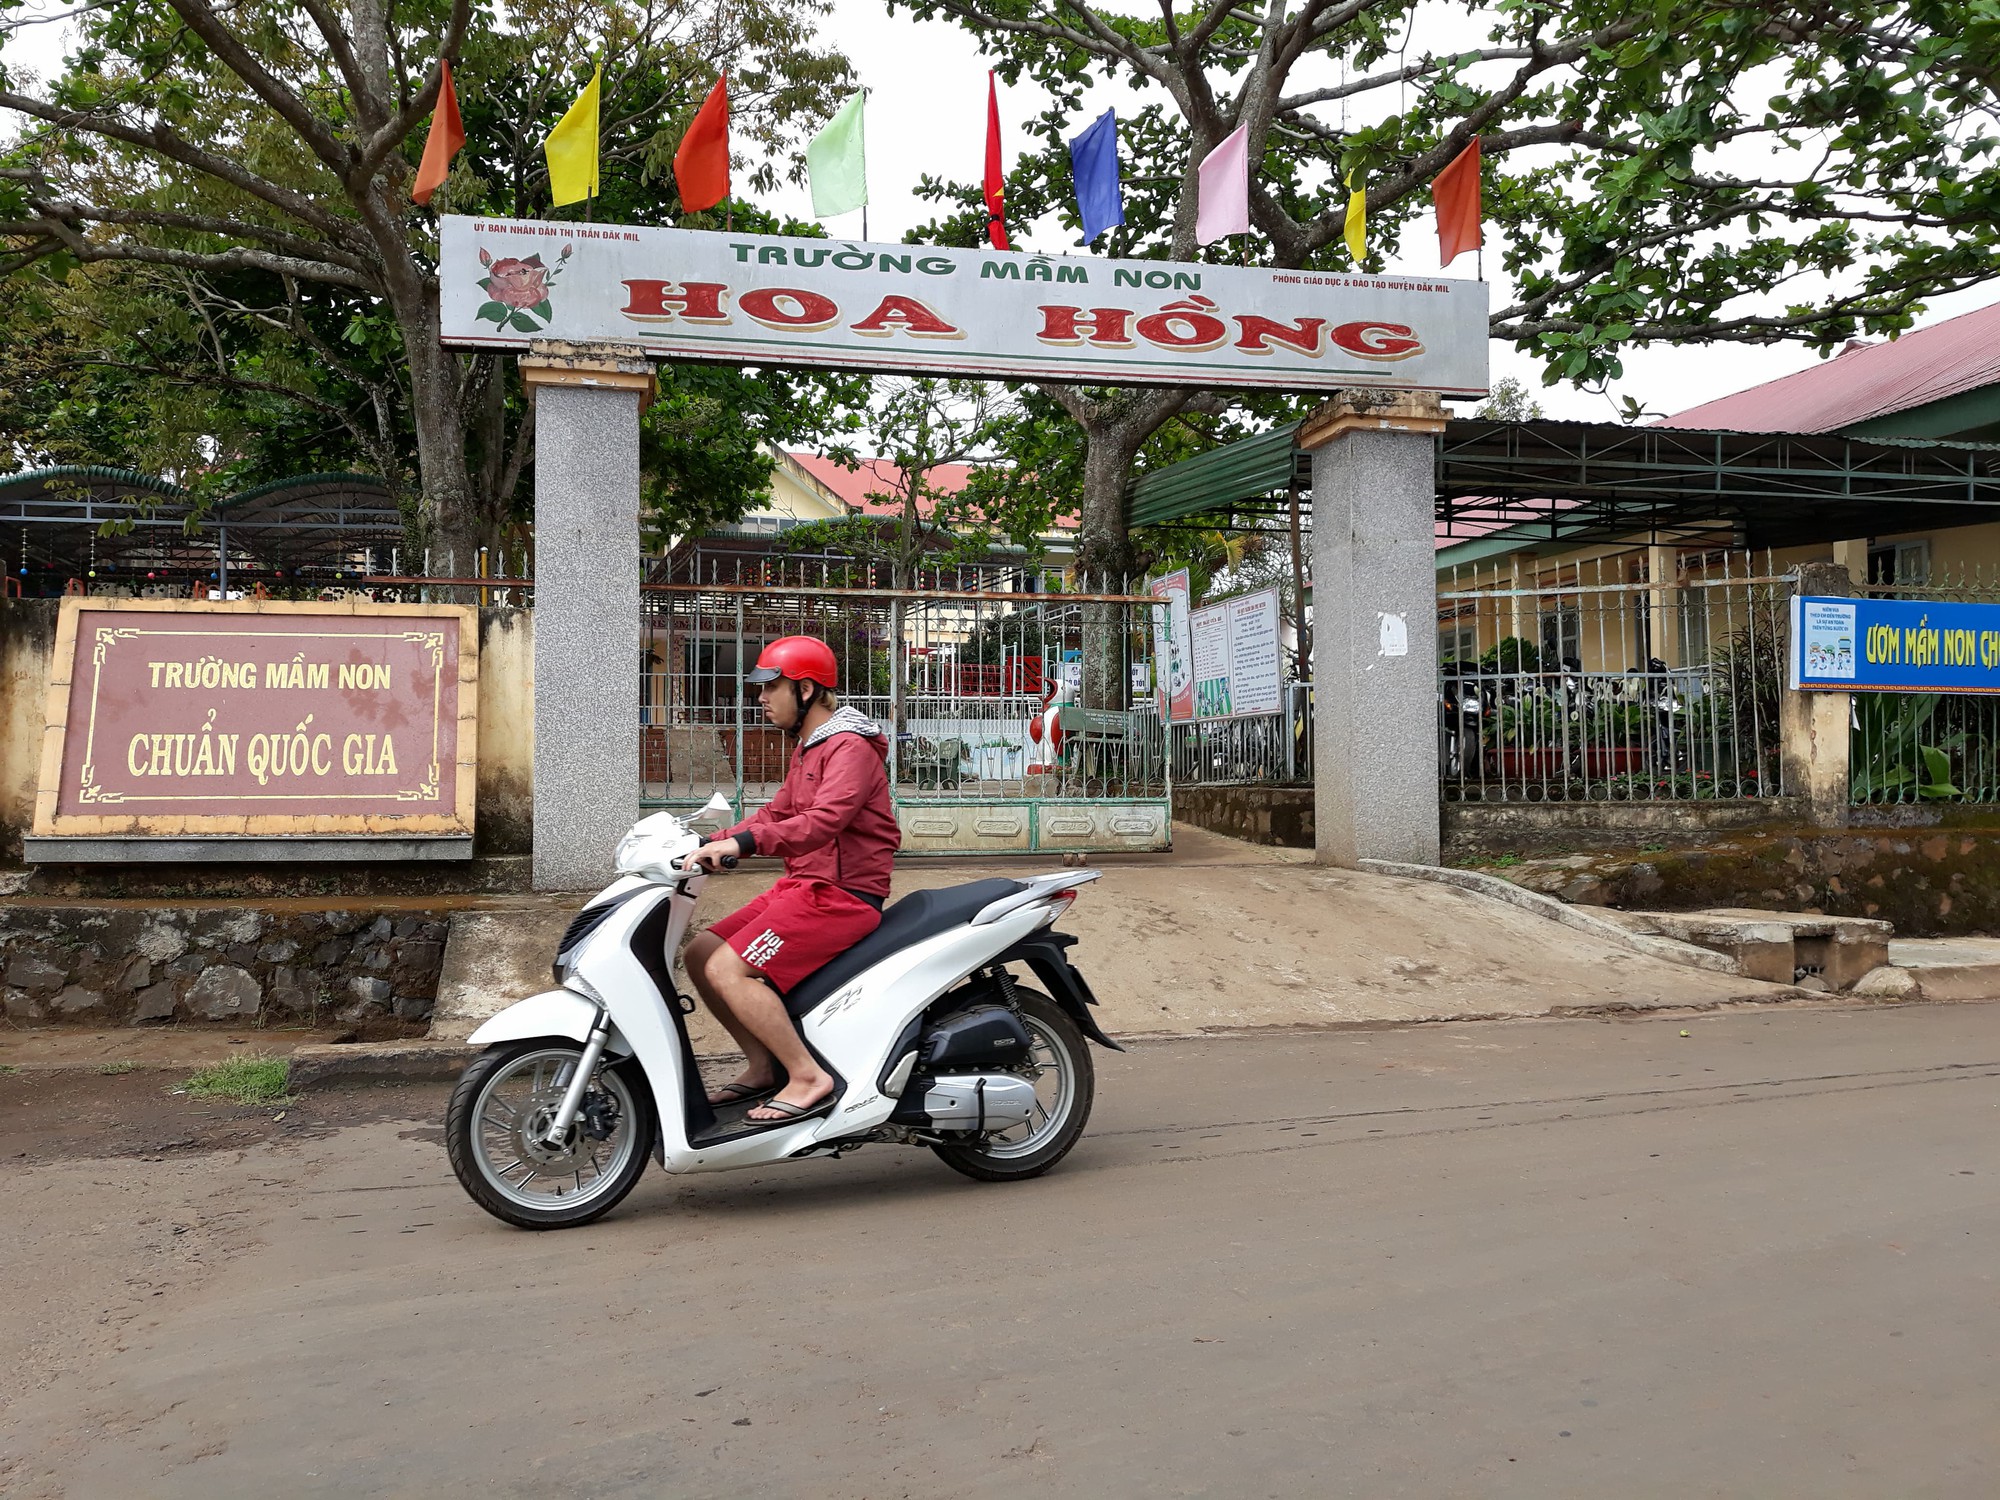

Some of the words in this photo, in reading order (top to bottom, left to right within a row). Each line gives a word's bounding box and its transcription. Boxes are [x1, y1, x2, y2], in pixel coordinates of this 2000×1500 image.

[488, 223, 507, 234] BAN
[510, 224, 536, 235] NHÂN
[538, 226, 557, 236] DÂN
[560, 228, 574, 239] THỊ
[576, 226, 600, 239] TRẤN
[623, 232, 641, 242] MIL
[729, 243, 957, 275] TRƯỜNG
[980, 255, 1089, 284] MẦM
[1115, 268, 1202, 290] NON
[1272, 273, 1301, 284] PHÒNG
[1303, 275, 1323, 285] GIÁO
[1325, 278, 1341, 288] DỤC
[1343, 279, 1350, 287] &
[1371, 280, 1386, 290] TẠO
[1388, 280, 1415, 292] HUYỆN
[1435, 284, 1450, 293] MIL
[620, 279, 966, 339] HOA
[1036, 295, 1424, 360] HỒNG
[1866, 623, 1900, 665] ƯƠM
[1944, 628, 1976, 667] NON
[1980, 630, 2000, 670] CH
[148, 656, 258, 690] TRƯỜNG
[265, 651, 330, 690] MẦM
[338, 662, 392, 690] NON
[127, 708, 240, 777] CHUẨN
[247, 713, 333, 786] QUỐC
[342, 733, 398, 776] GIA
